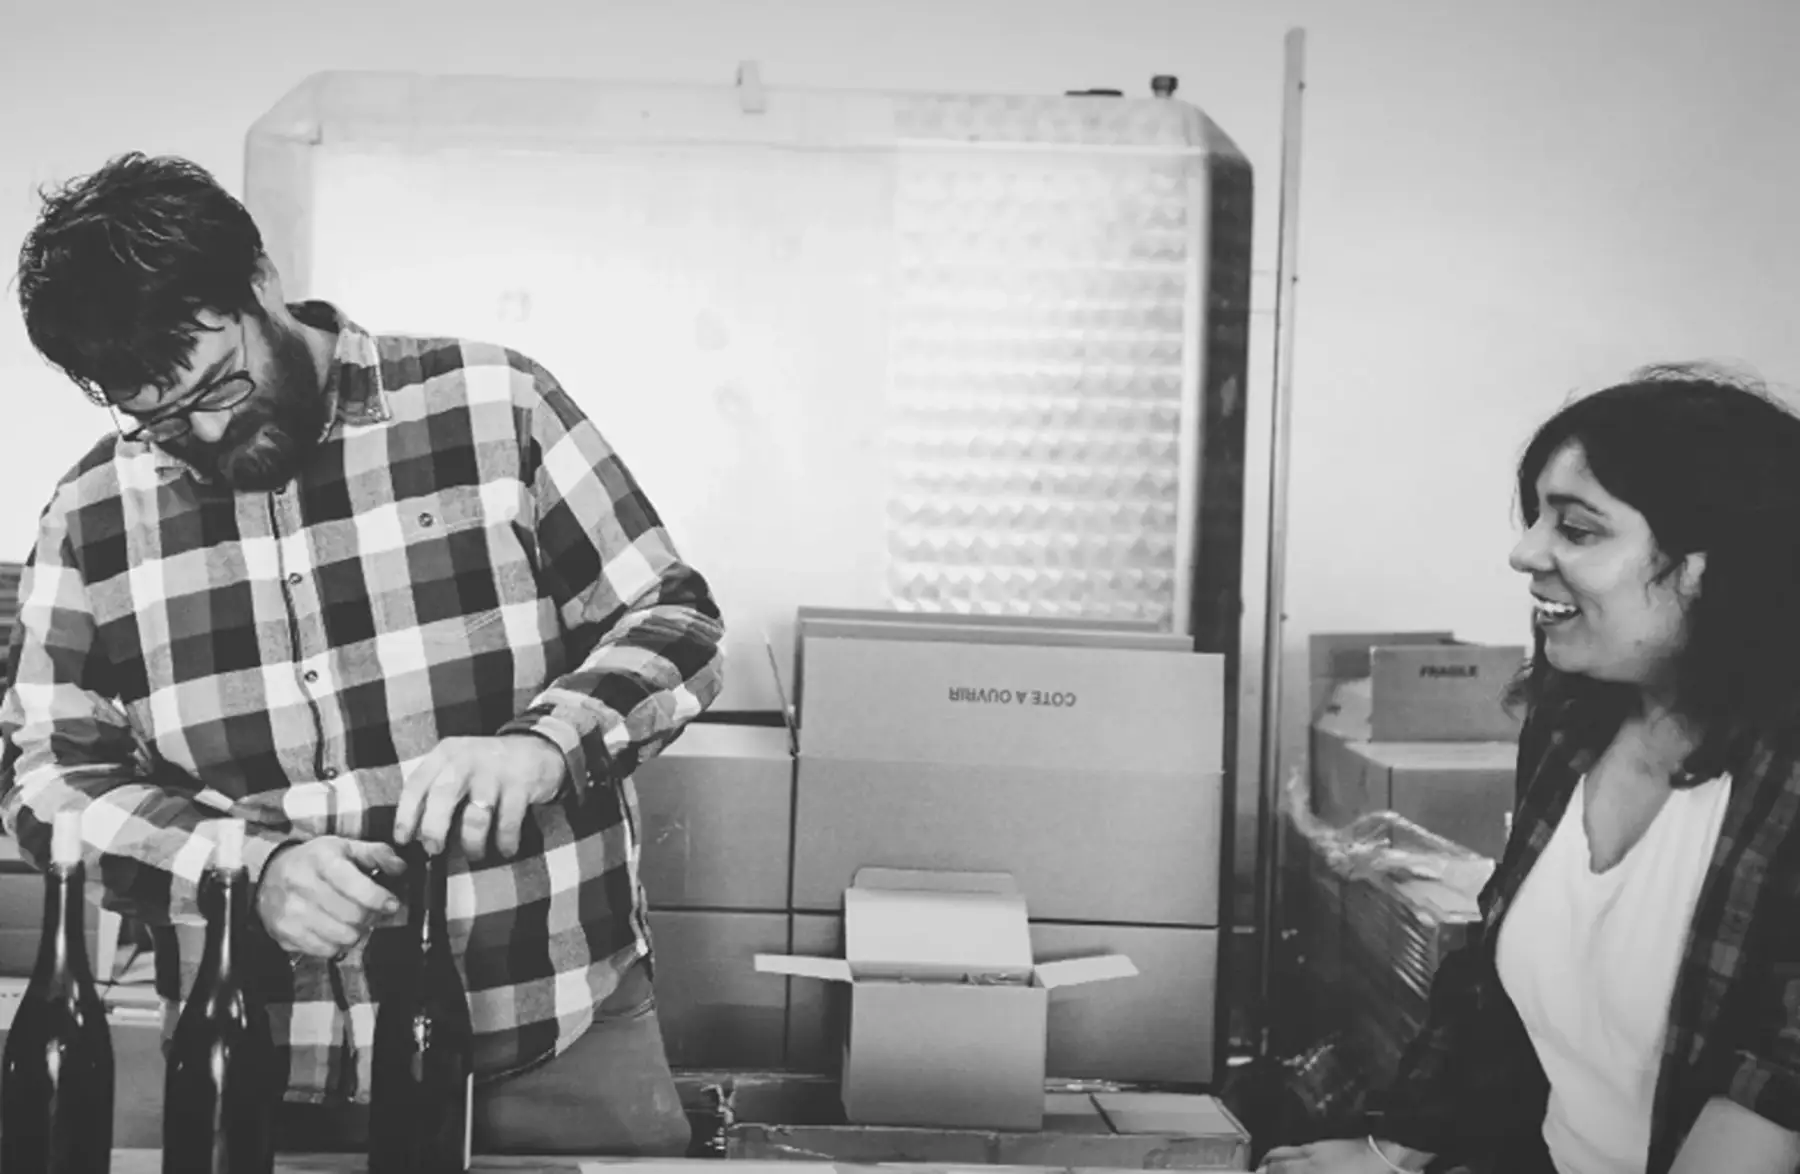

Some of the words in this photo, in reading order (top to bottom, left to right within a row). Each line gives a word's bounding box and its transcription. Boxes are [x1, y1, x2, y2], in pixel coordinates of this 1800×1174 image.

[949, 687, 1012, 704] OUVRIR
[1016, 691, 1027, 704] A
[1031, 690, 1077, 707] COTE
